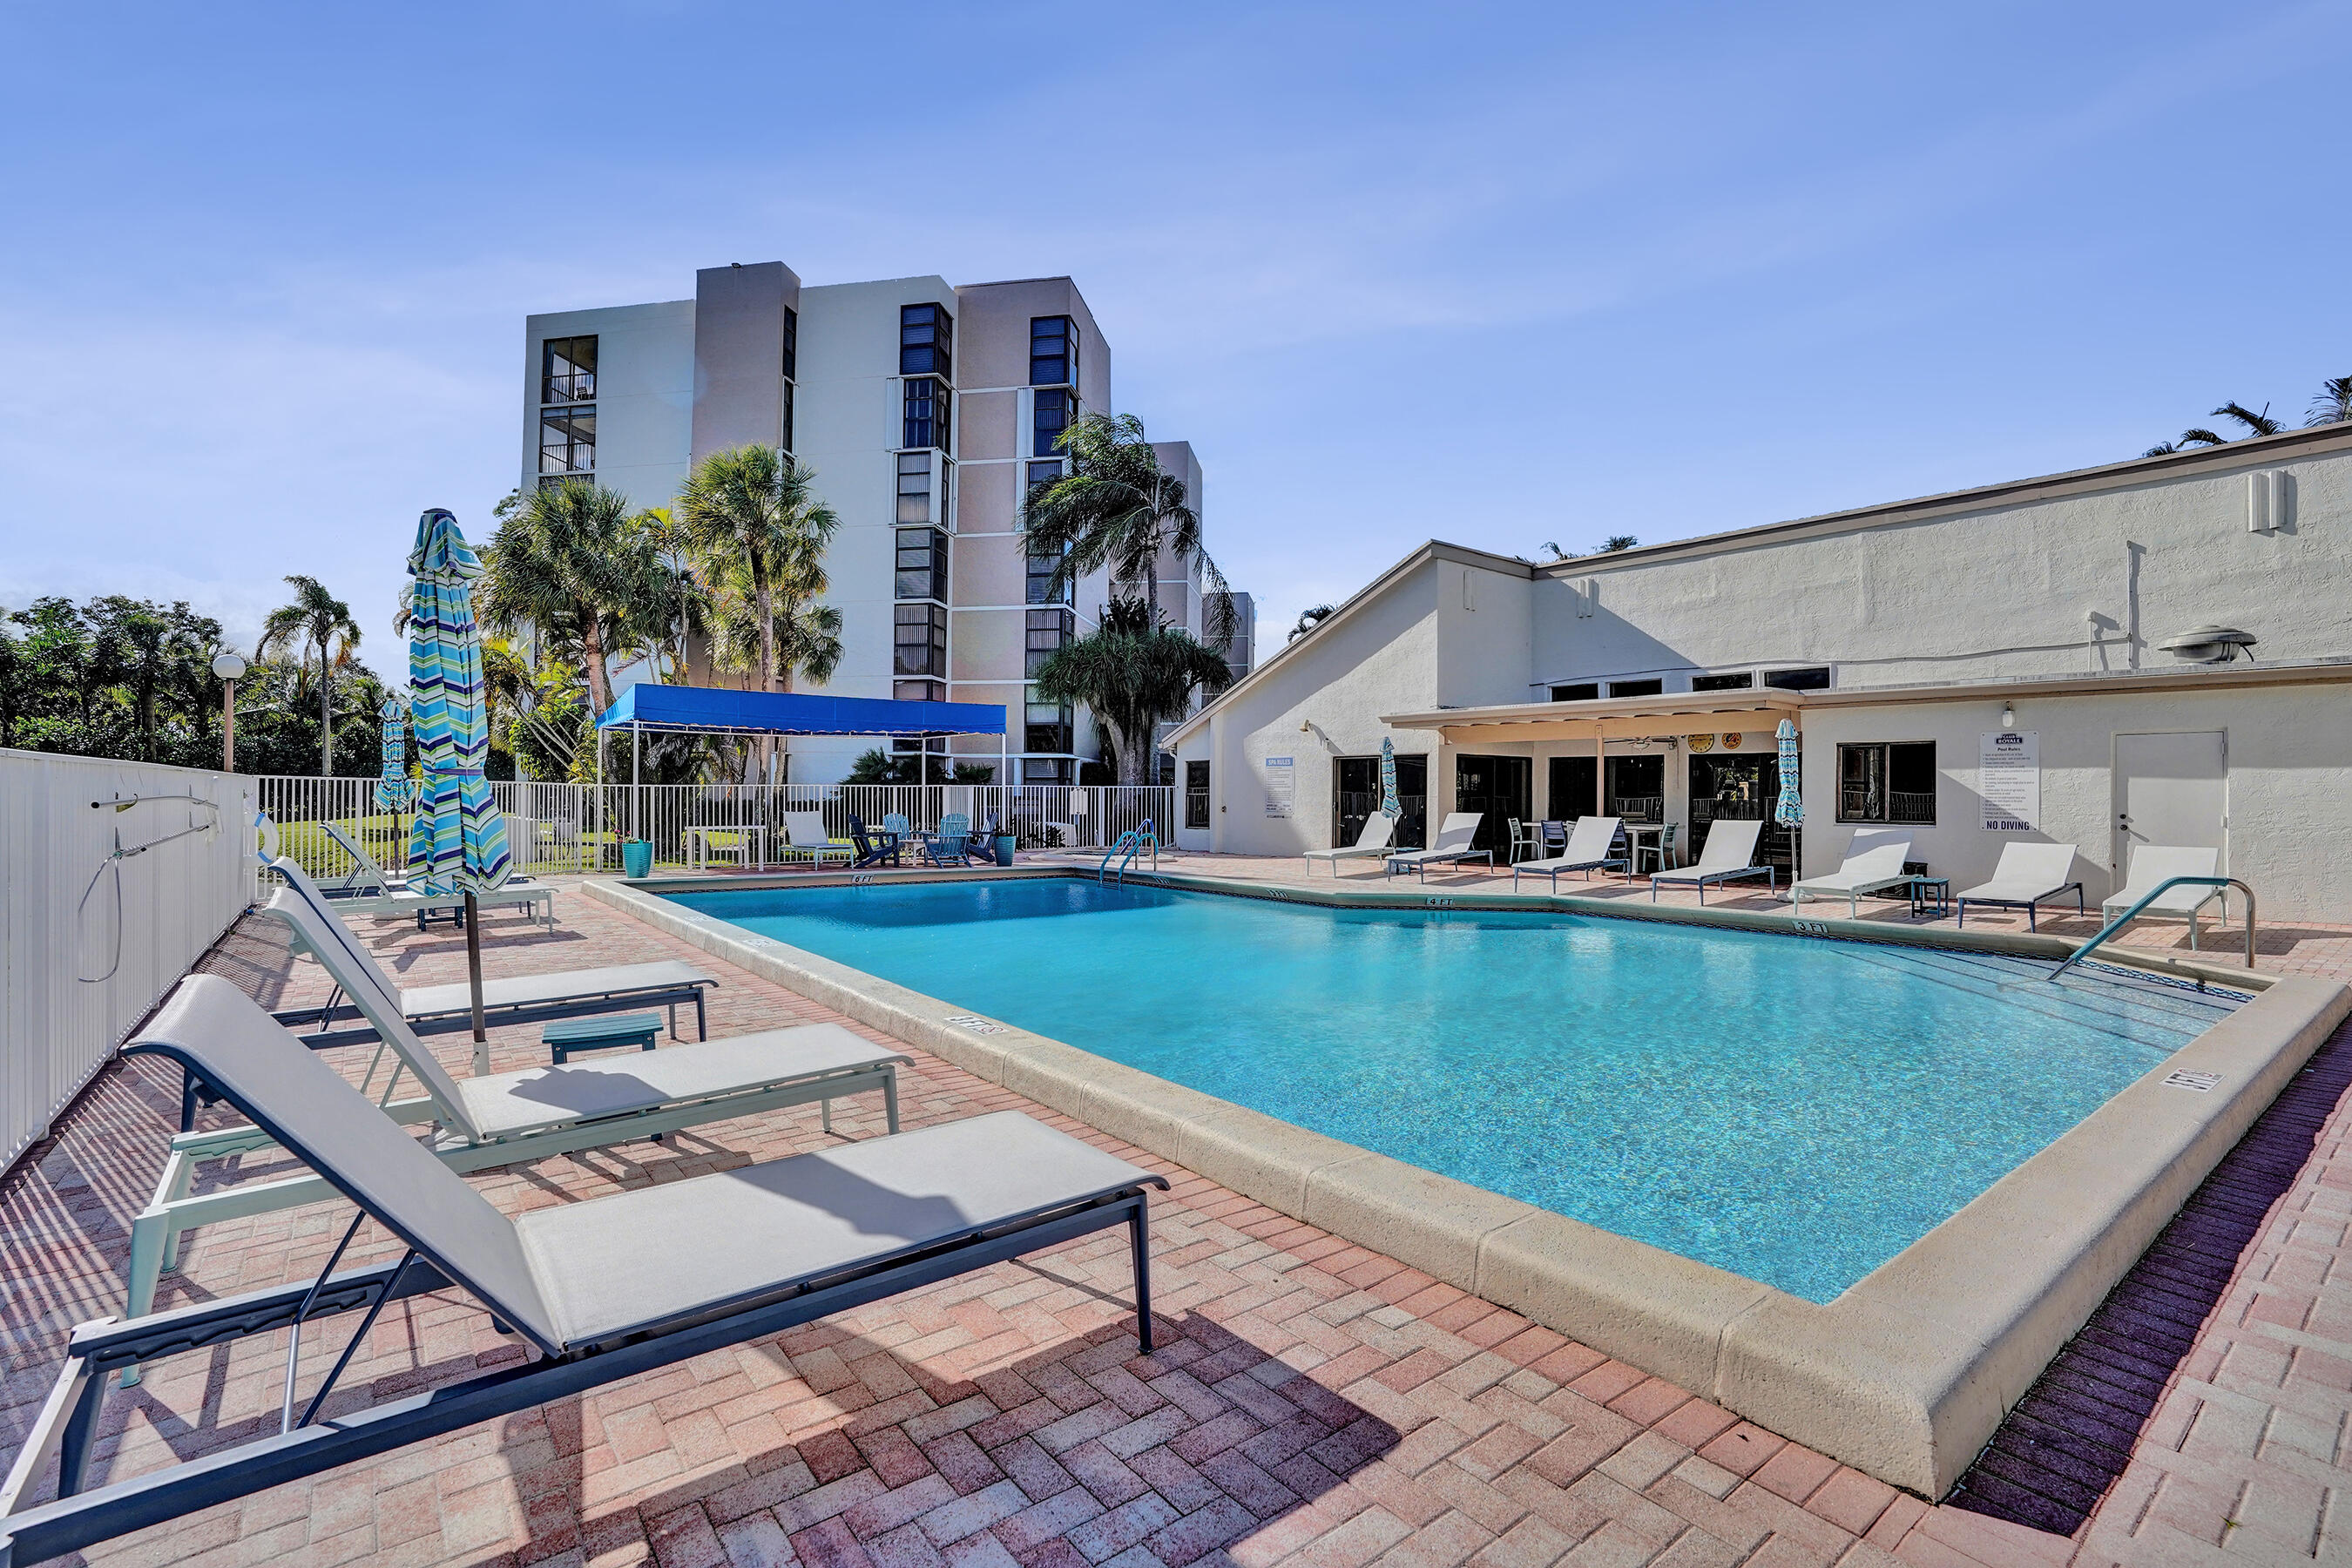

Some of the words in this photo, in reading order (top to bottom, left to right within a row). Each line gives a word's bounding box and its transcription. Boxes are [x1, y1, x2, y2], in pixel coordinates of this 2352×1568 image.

[1986, 821, 1998, 830] NO
[2001, 821, 2030, 830] DIVING
[1798, 922, 1806, 930] 3
[1809, 923, 1825, 933] FT
[958, 1019, 994, 1028] FT
